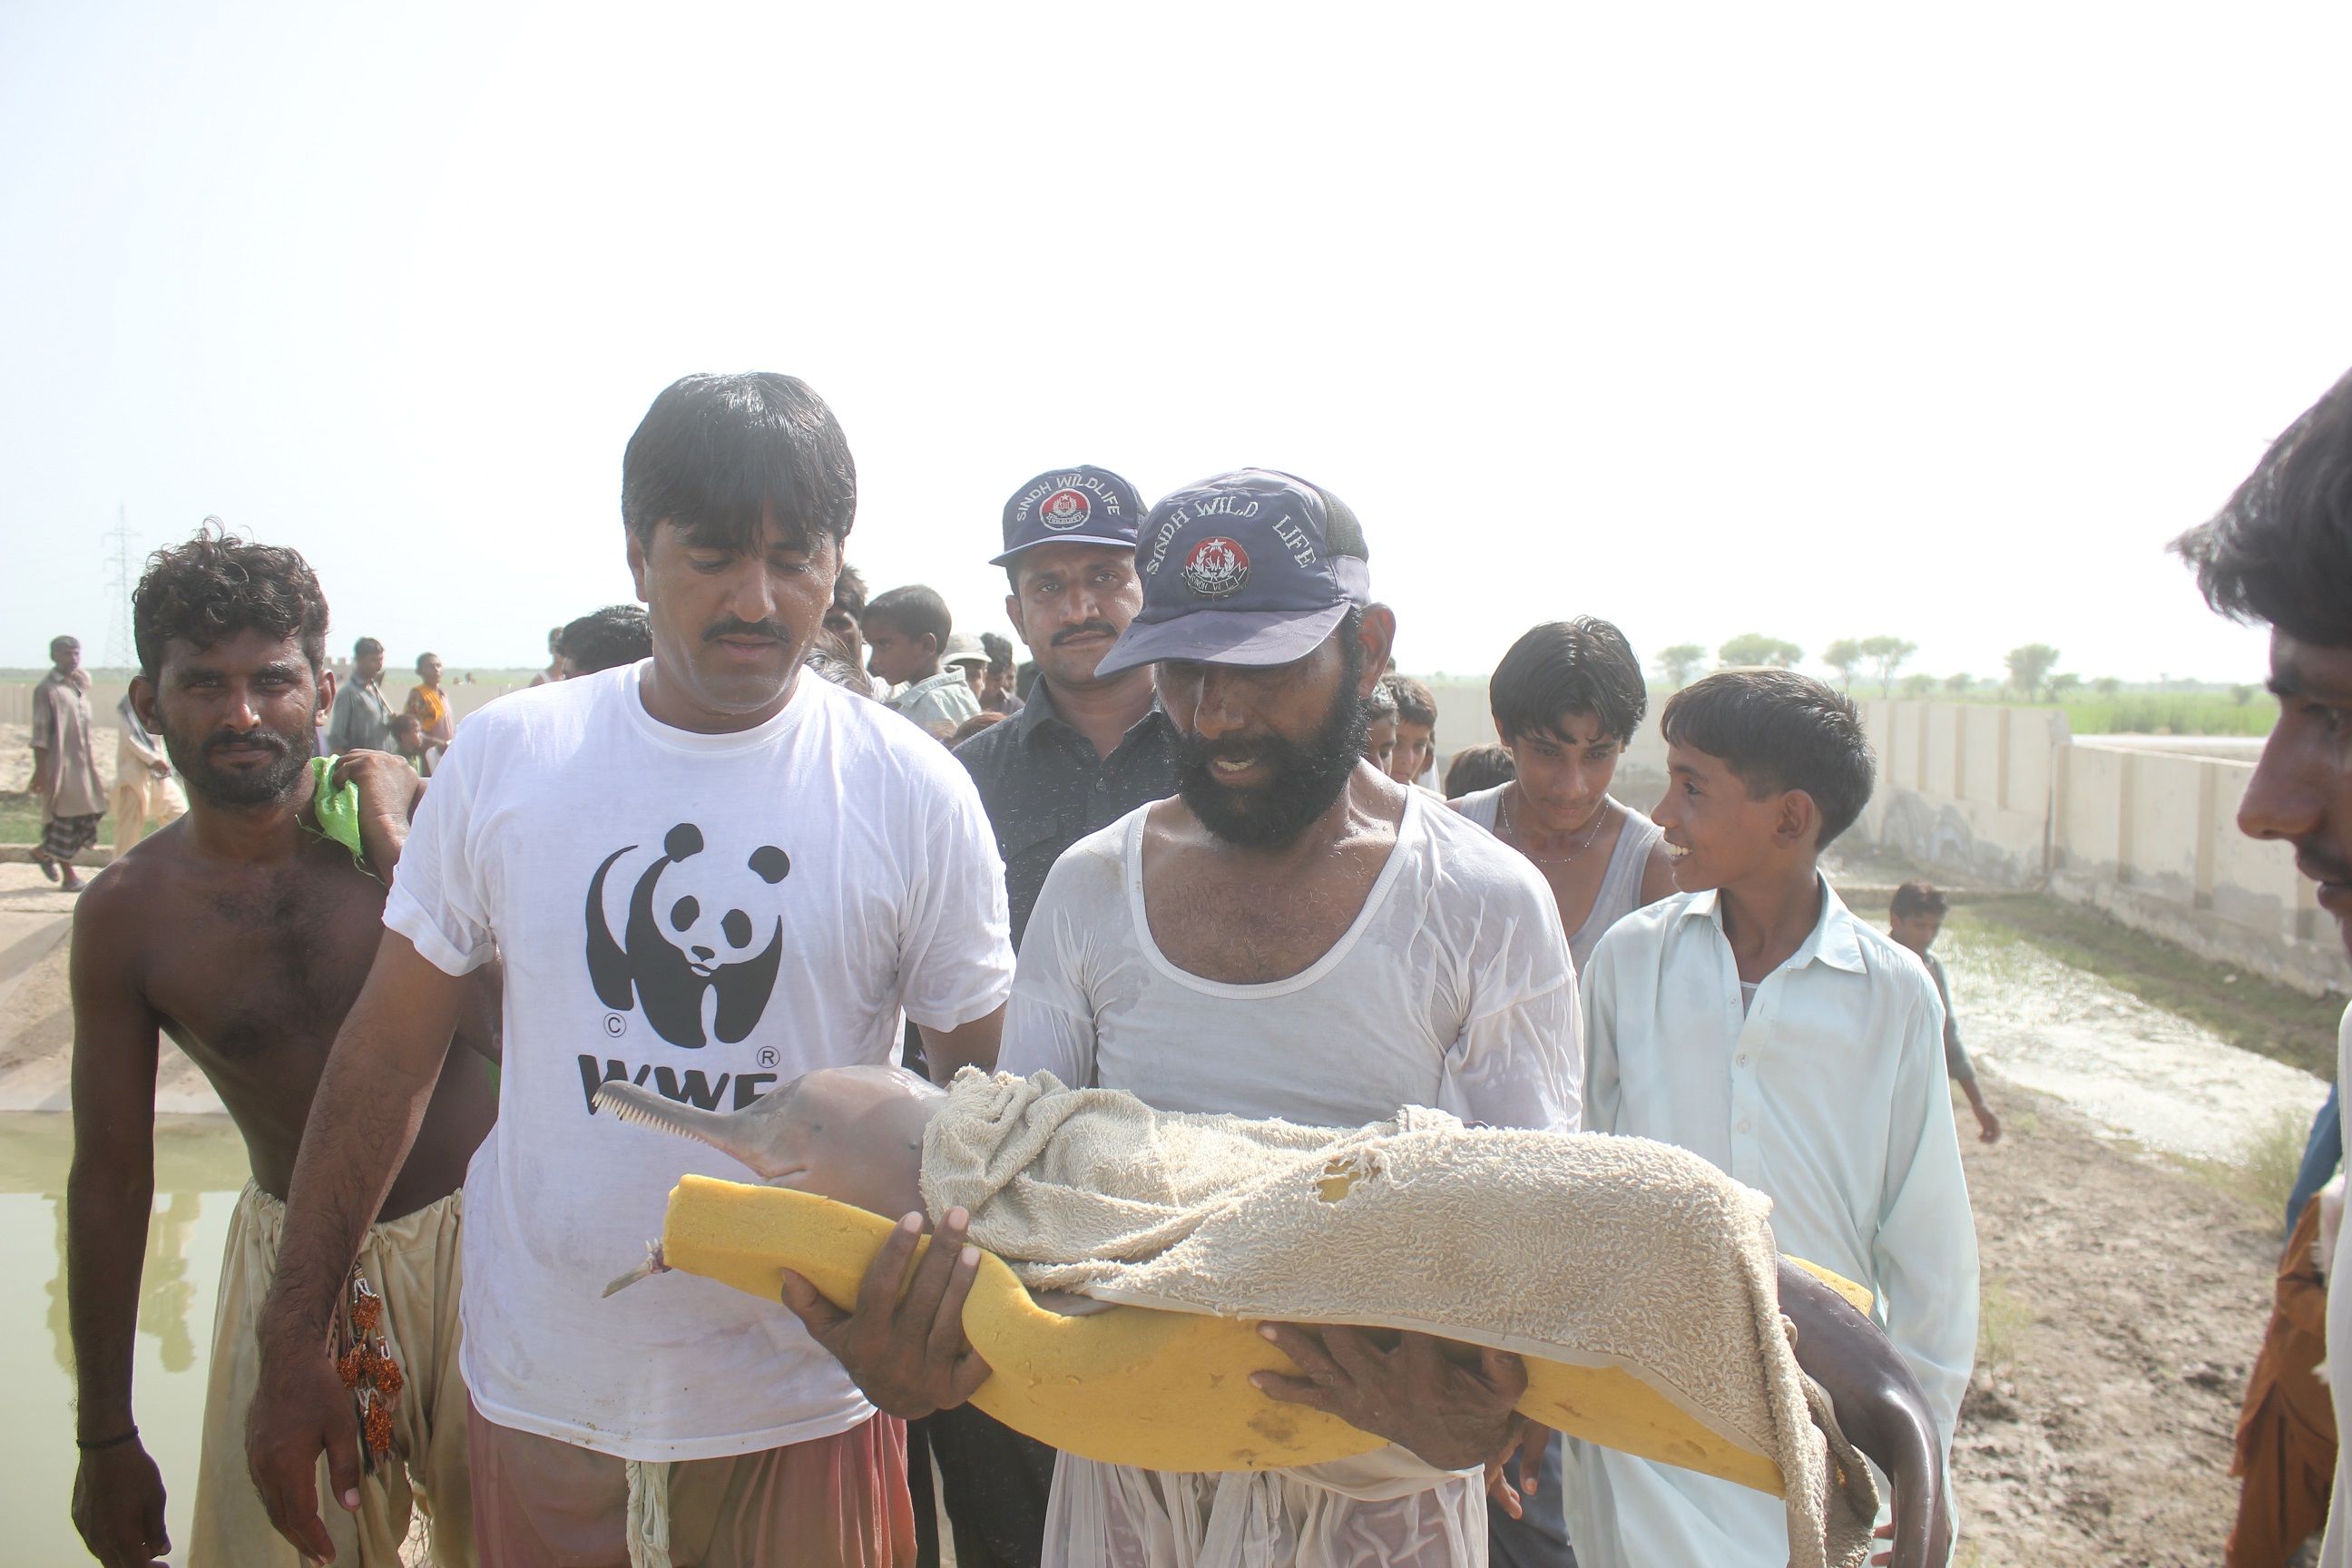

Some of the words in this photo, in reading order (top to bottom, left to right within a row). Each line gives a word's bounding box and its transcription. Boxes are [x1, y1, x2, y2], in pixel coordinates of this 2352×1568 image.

[1016, 481, 1053, 522] SINDH
[1055, 475, 1121, 515] WILDLIFE
[1146, 506, 1191, 575] SINDH
[1193, 495, 1259, 518] WILD
[1272, 514, 1317, 569] LIFE
